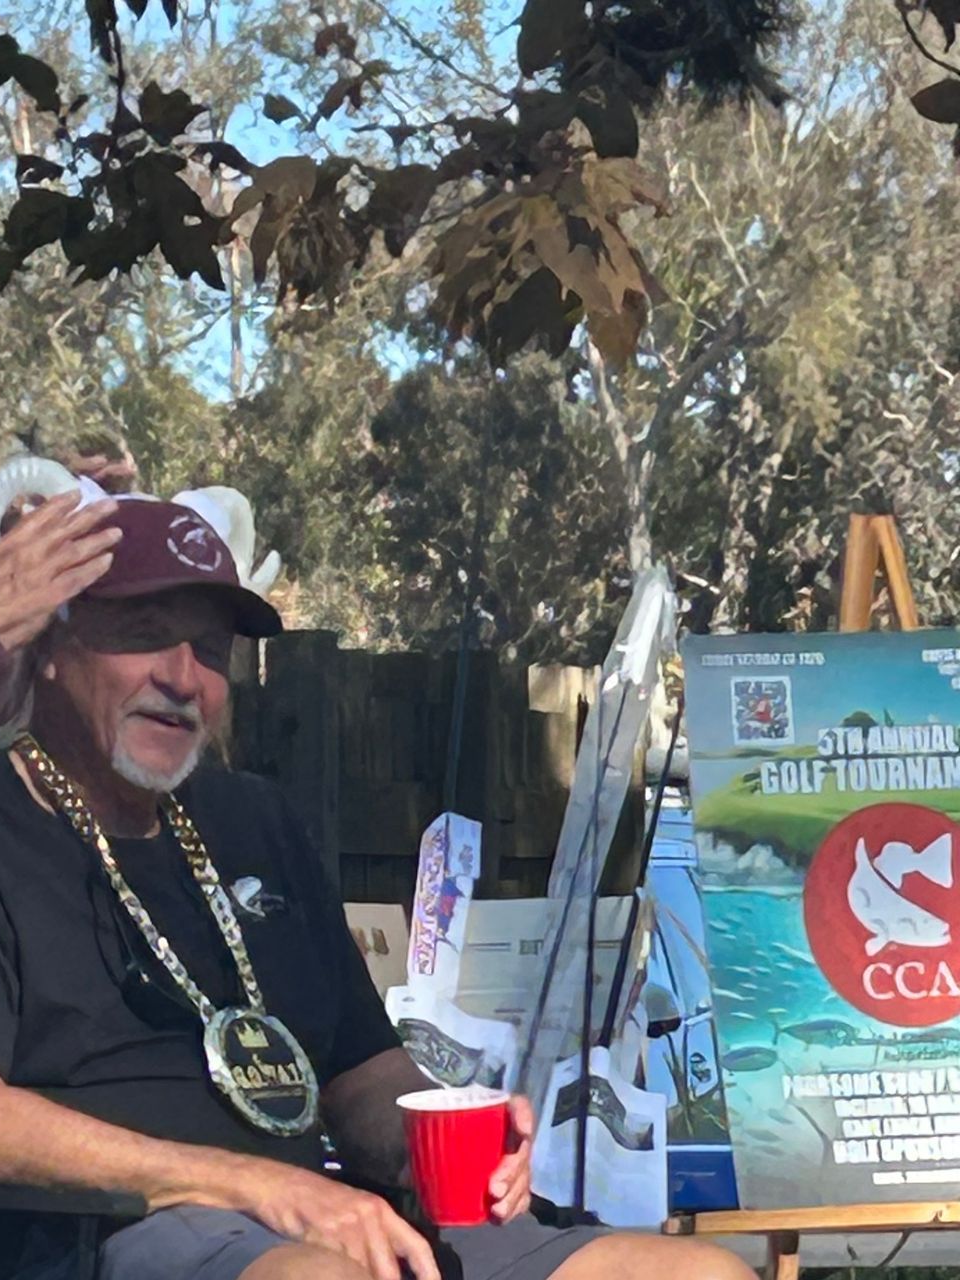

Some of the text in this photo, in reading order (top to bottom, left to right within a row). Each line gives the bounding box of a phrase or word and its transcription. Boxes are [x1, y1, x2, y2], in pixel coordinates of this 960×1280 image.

[866, 724, 960, 754] ANNUAL
[759, 758, 829, 795] GOLF
[862, 961, 960, 1000] CCA
